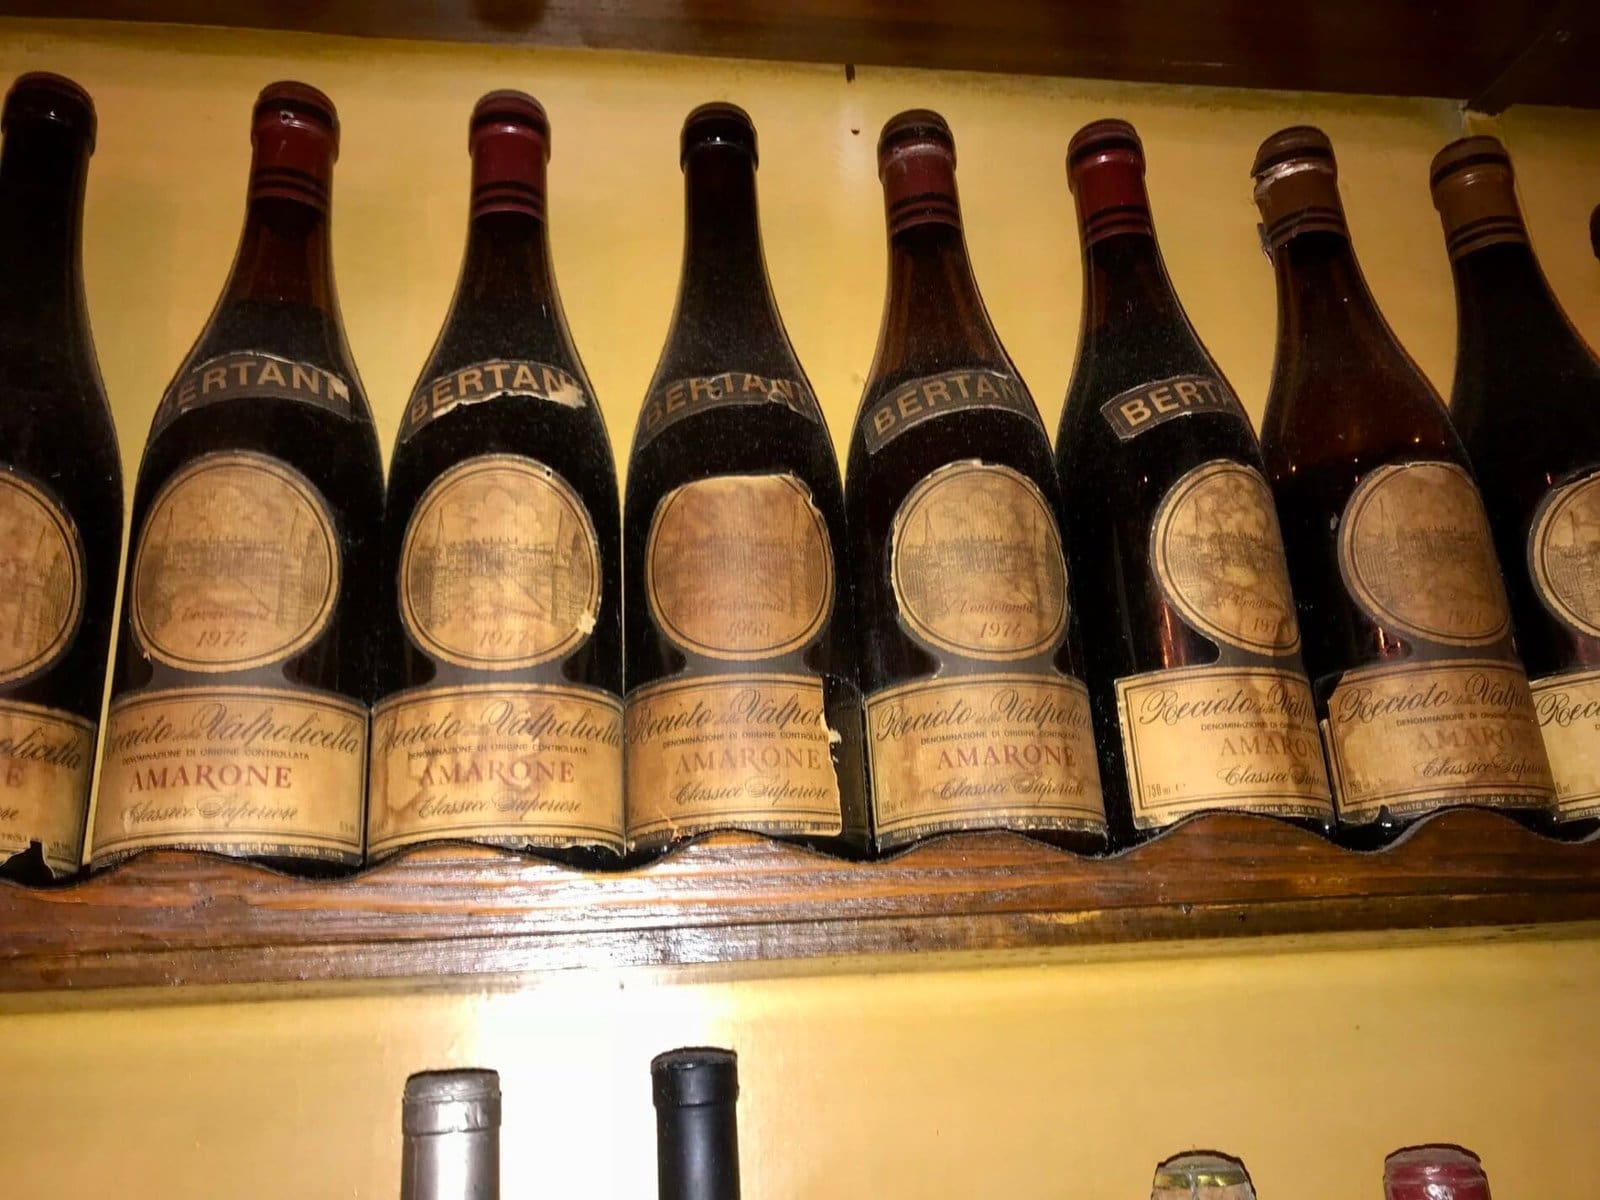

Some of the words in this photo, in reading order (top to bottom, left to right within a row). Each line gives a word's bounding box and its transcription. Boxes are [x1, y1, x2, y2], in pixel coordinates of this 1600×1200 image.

[411, 363, 572, 425] BERTAN
[647, 372, 795, 430] BERTAN
[873, 373, 1022, 436] BERTAN
[978, 621, 1024, 639] 1974
[1139, 689, 1253, 727] Recioto
[1337, 682, 1448, 724] Recioto
[1220, 734, 1320, 761] AMARON
[1415, 726, 1515, 751] AMARO
[674, 748, 823, 776] AMARONE
[936, 743, 1077, 771] AMARONE
[129, 763, 294, 793] AMARONE
[418, 759, 576, 790] AMARONE
